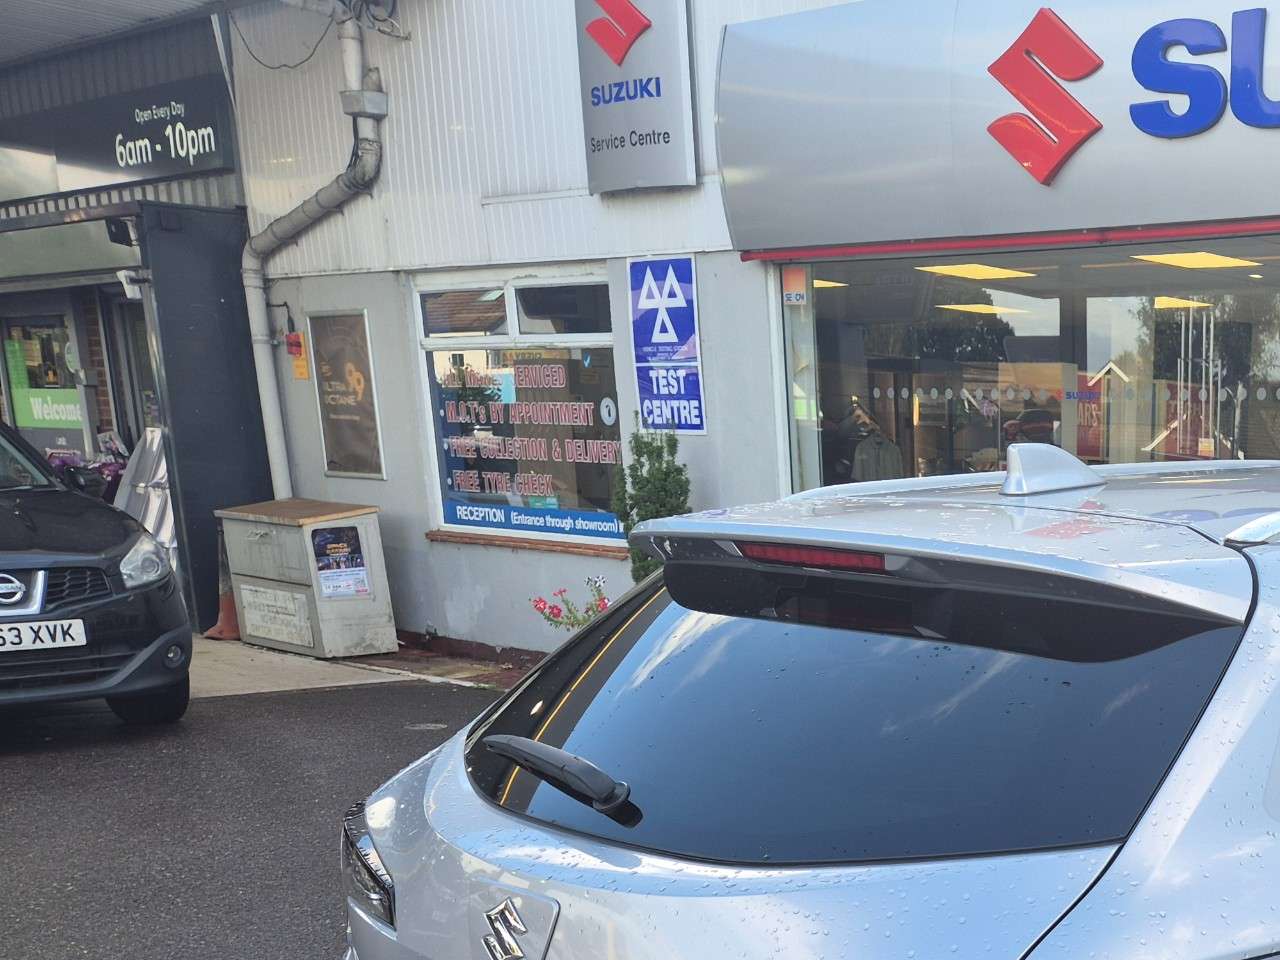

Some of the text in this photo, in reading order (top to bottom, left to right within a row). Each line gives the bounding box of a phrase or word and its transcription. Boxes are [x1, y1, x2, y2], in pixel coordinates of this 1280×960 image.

[591, 76, 662, 107] SUZUKI
[135, 101, 185, 125] Open Every Day
[115, 133, 152, 167] 6am
[164, 121, 216, 166] 10pm
[590, 129, 671, 153] Service Centre
[508, 364, 567, 388] ERVICED
[649, 369, 687, 395] TEST
[30, 396, 83, 421] Welcome
[446, 401, 595, 426] M.O.T's BY APPOINTMENT
[642, 399, 701, 425] CENTRE
[450, 436, 622, 465] FREE COLLECTION & DELIVERY
[452, 470, 554, 497] FREE TYRE CHECK
[456, 505, 505, 523] RECEPTION
[511, 511, 545, 528] (Entrance
[545, 514, 574, 531] through
[29, 623, 76, 645] XVK
